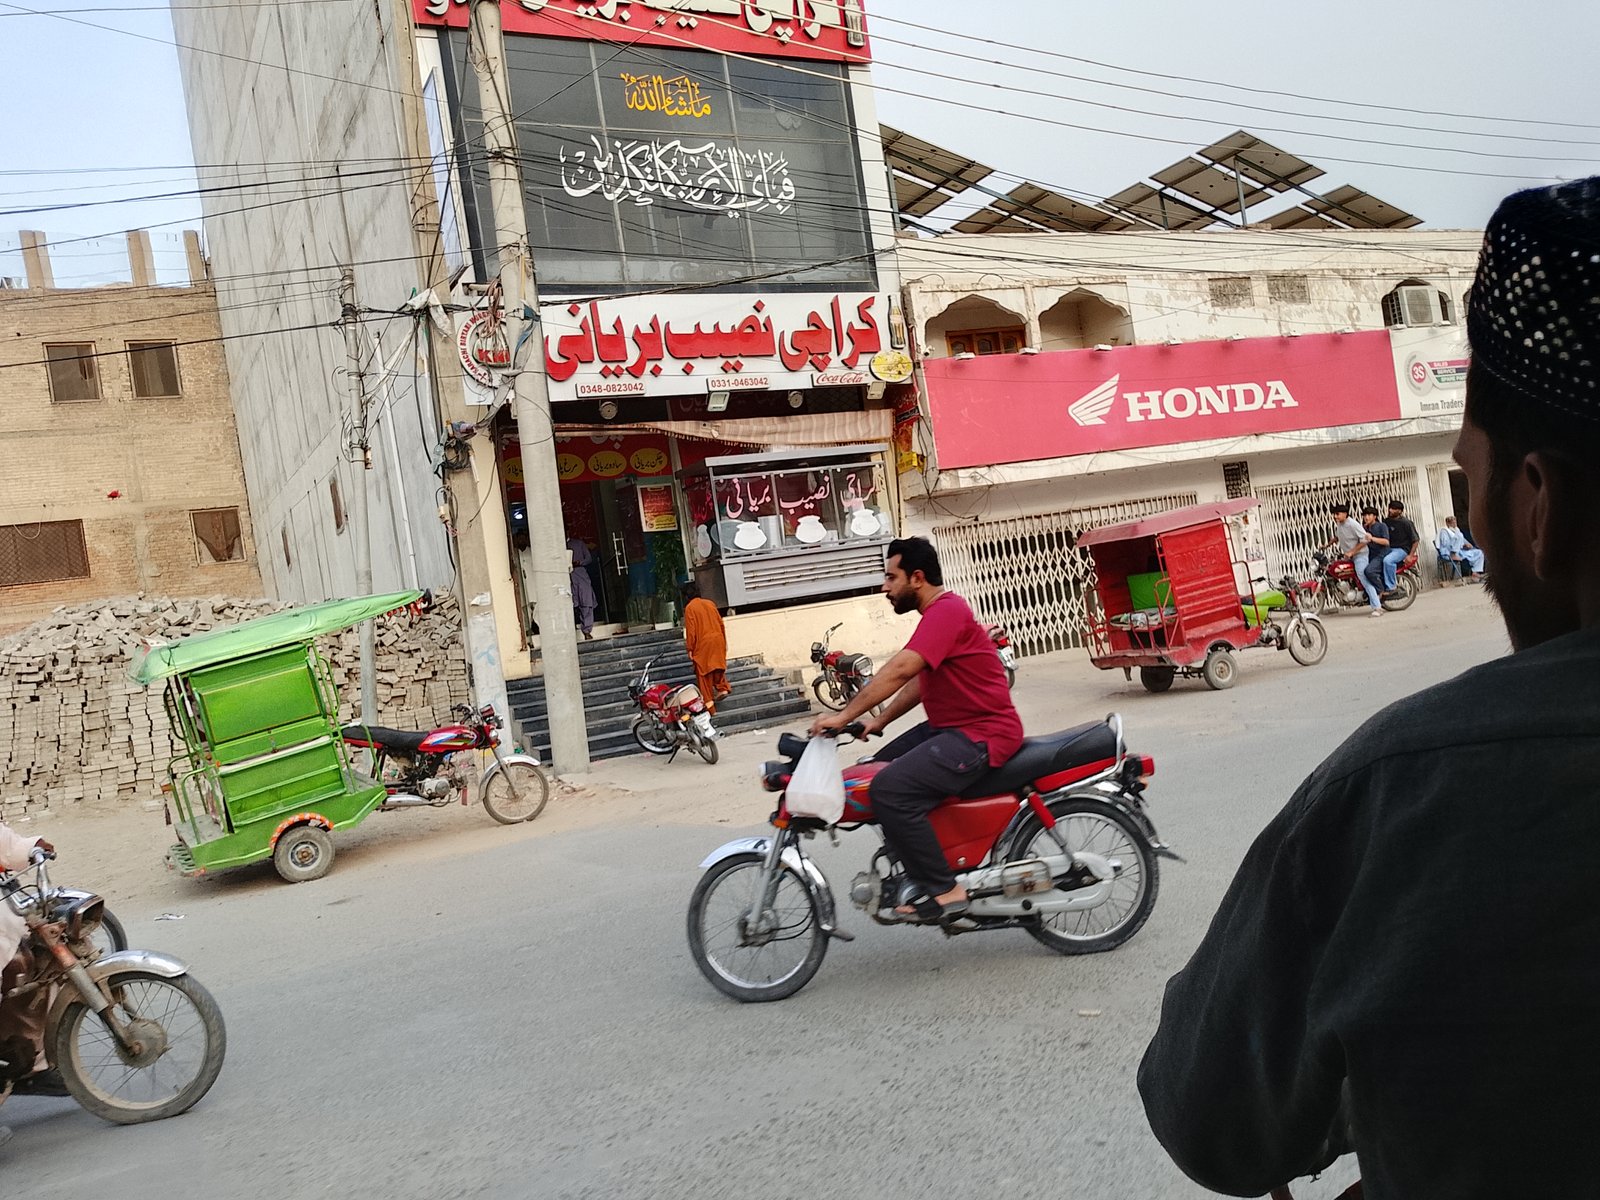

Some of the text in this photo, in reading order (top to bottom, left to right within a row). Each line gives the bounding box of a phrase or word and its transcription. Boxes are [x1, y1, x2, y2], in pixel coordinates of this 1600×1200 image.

[545, 295, 881, 383] کراچی نصیب بریانی
[711, 377, 769, 388] 0331-0463042
[1412, 366, 1424, 380] 3S
[580, 382, 644, 394] 0348-0823042
[1123, 380, 1299, 422] HONDA
[1420, 399, 1464, 411] Imran Traders
[726, 478, 771, 518] بریانی
[780, 475, 830, 515] نصیب
